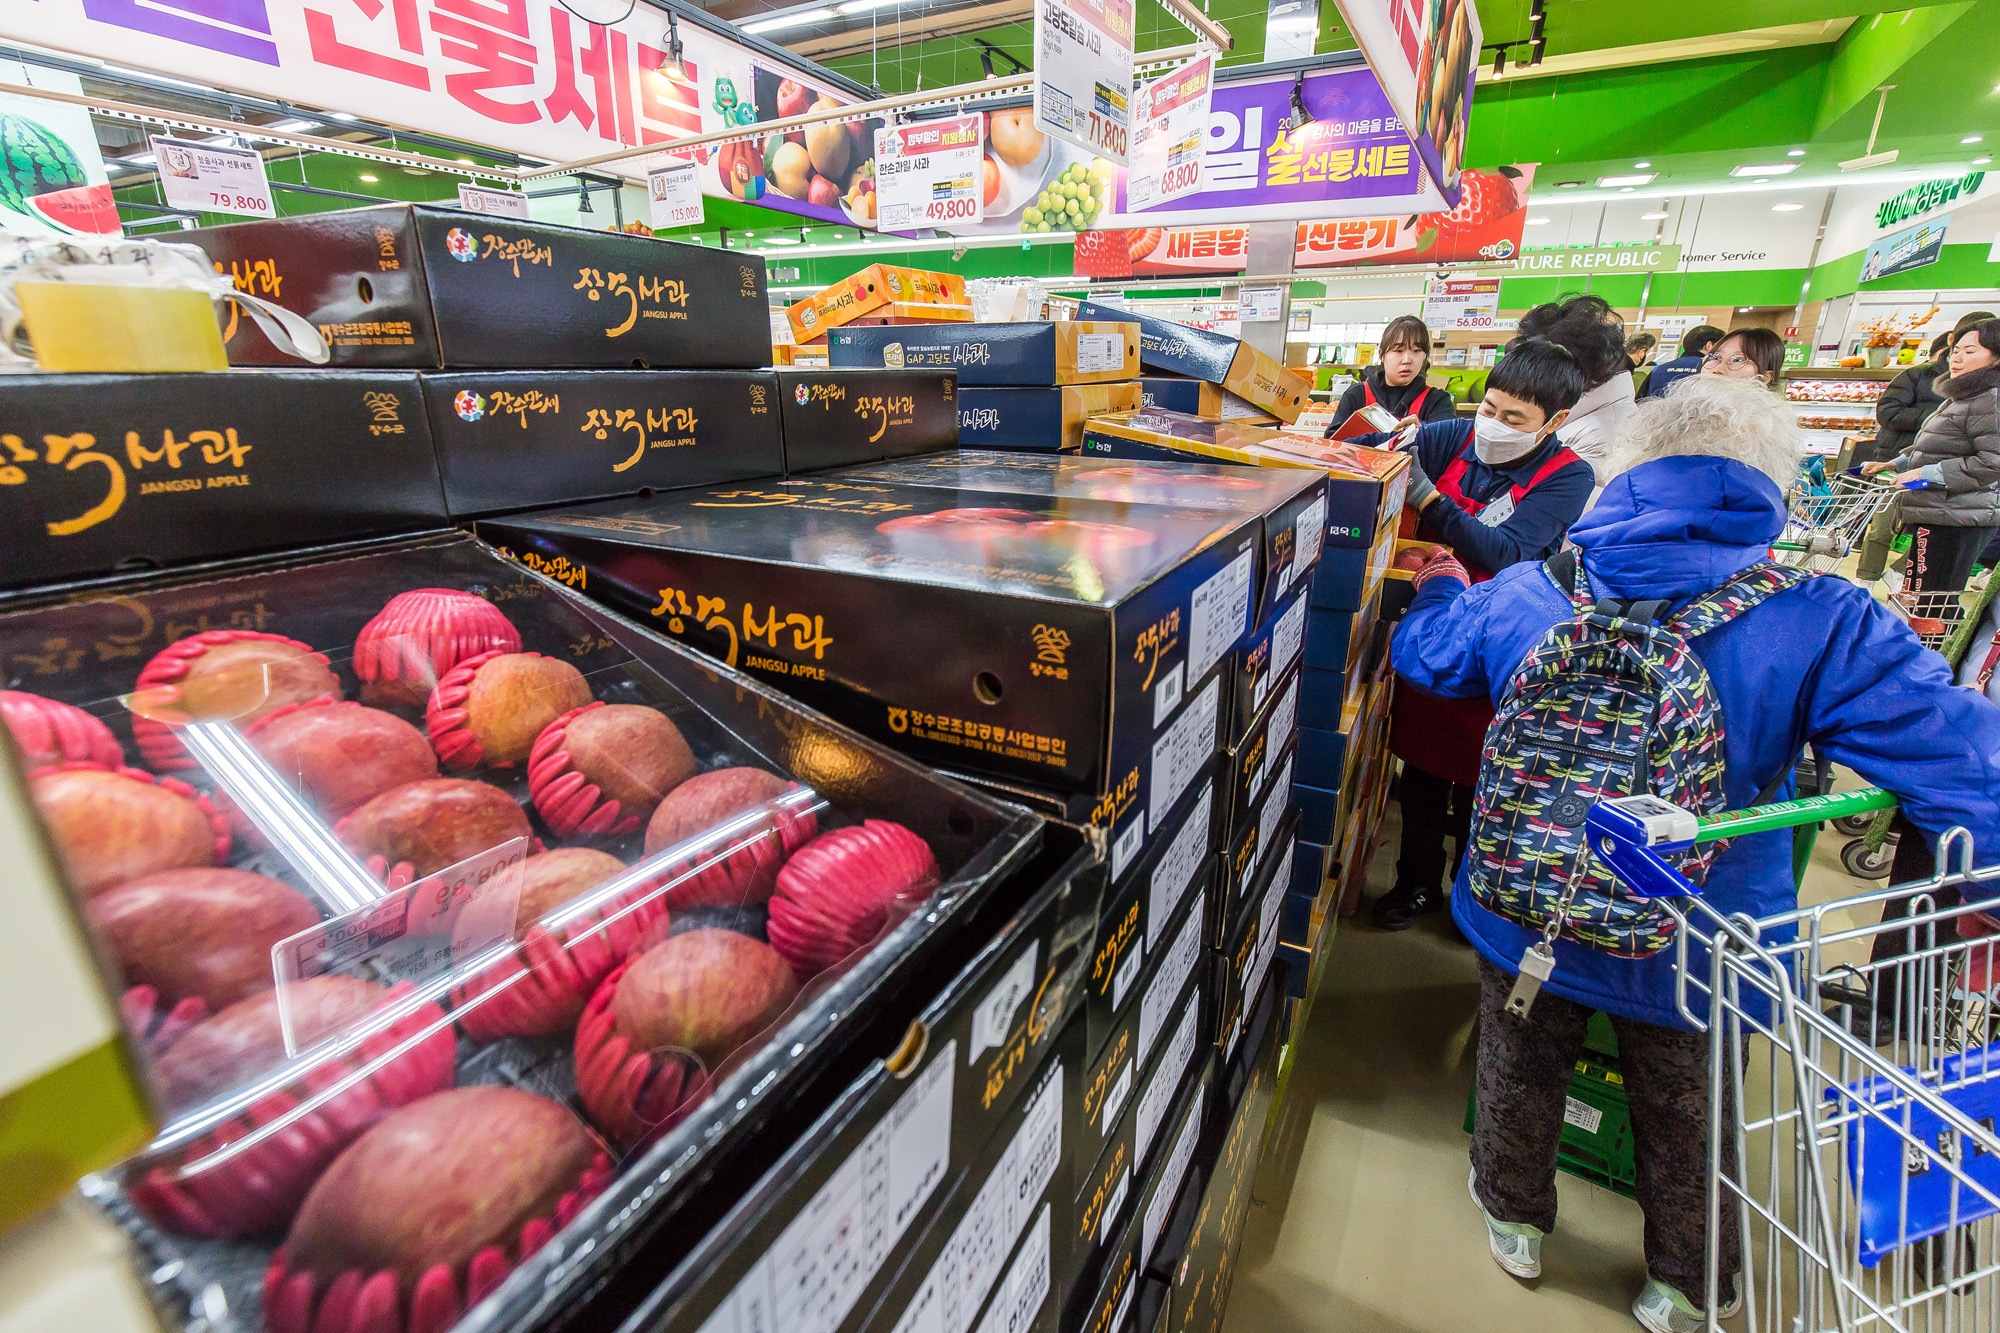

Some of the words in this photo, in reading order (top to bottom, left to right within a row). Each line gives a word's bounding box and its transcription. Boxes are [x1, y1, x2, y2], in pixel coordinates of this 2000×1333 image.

[1086, 29, 1101, 57] 사과
[907, 129, 940, 147] 정부할인
[941, 128, 976, 146] 지원행사
[1089, 110, 1127, 157] 71,800
[1312, 123, 1344, 139] 감사의
[1347, 118, 1382, 135] 마음을
[879, 159, 911, 176] 한손과일
[912, 157, 930, 171] 사과
[1302, 144, 1411, 183] 선물세트
[1161, 161, 1199, 195] 68,800
[209, 192, 267, 211] 79,800
[926, 198, 976, 221] 49,800
[671, 206, 700, 221] 125,000
[1166, 227, 1251, 260] 새콤달
[1571, 250, 1661, 269] REPUBLIC
[1679, 253, 1717, 262] tomer
[1720, 250, 1766, 262] Service
[836, 291, 855, 309] 사과
[642, 309, 668, 320] JANGSU
[669, 311, 688, 321] APPLE
[1456, 317, 1492, 327] 56,800
[839, 336, 852, 345] 농협
[1159, 339, 1188, 359] 사과
[906, 354, 924, 364] GAP
[926, 352, 951, 365] 고당도
[952, 342, 991, 366] 사과
[1783, 354, 1804, 362] ALE
[963, 407, 1000, 430] 사과
[650, 439, 676, 449] JANGSU
[677, 437, 696, 447] APPLE
[1096, 442, 1112, 453] 농협
[139, 477, 203, 495] JANGSU
[206, 473, 250, 489] APPLE
[745, 654, 788, 675] JANGSU
[791, 665, 826, 682] APPLE
[1029, 662, 1069, 680] 장수군
[910, 709, 1066, 756] 장수군조합공동사업법인
